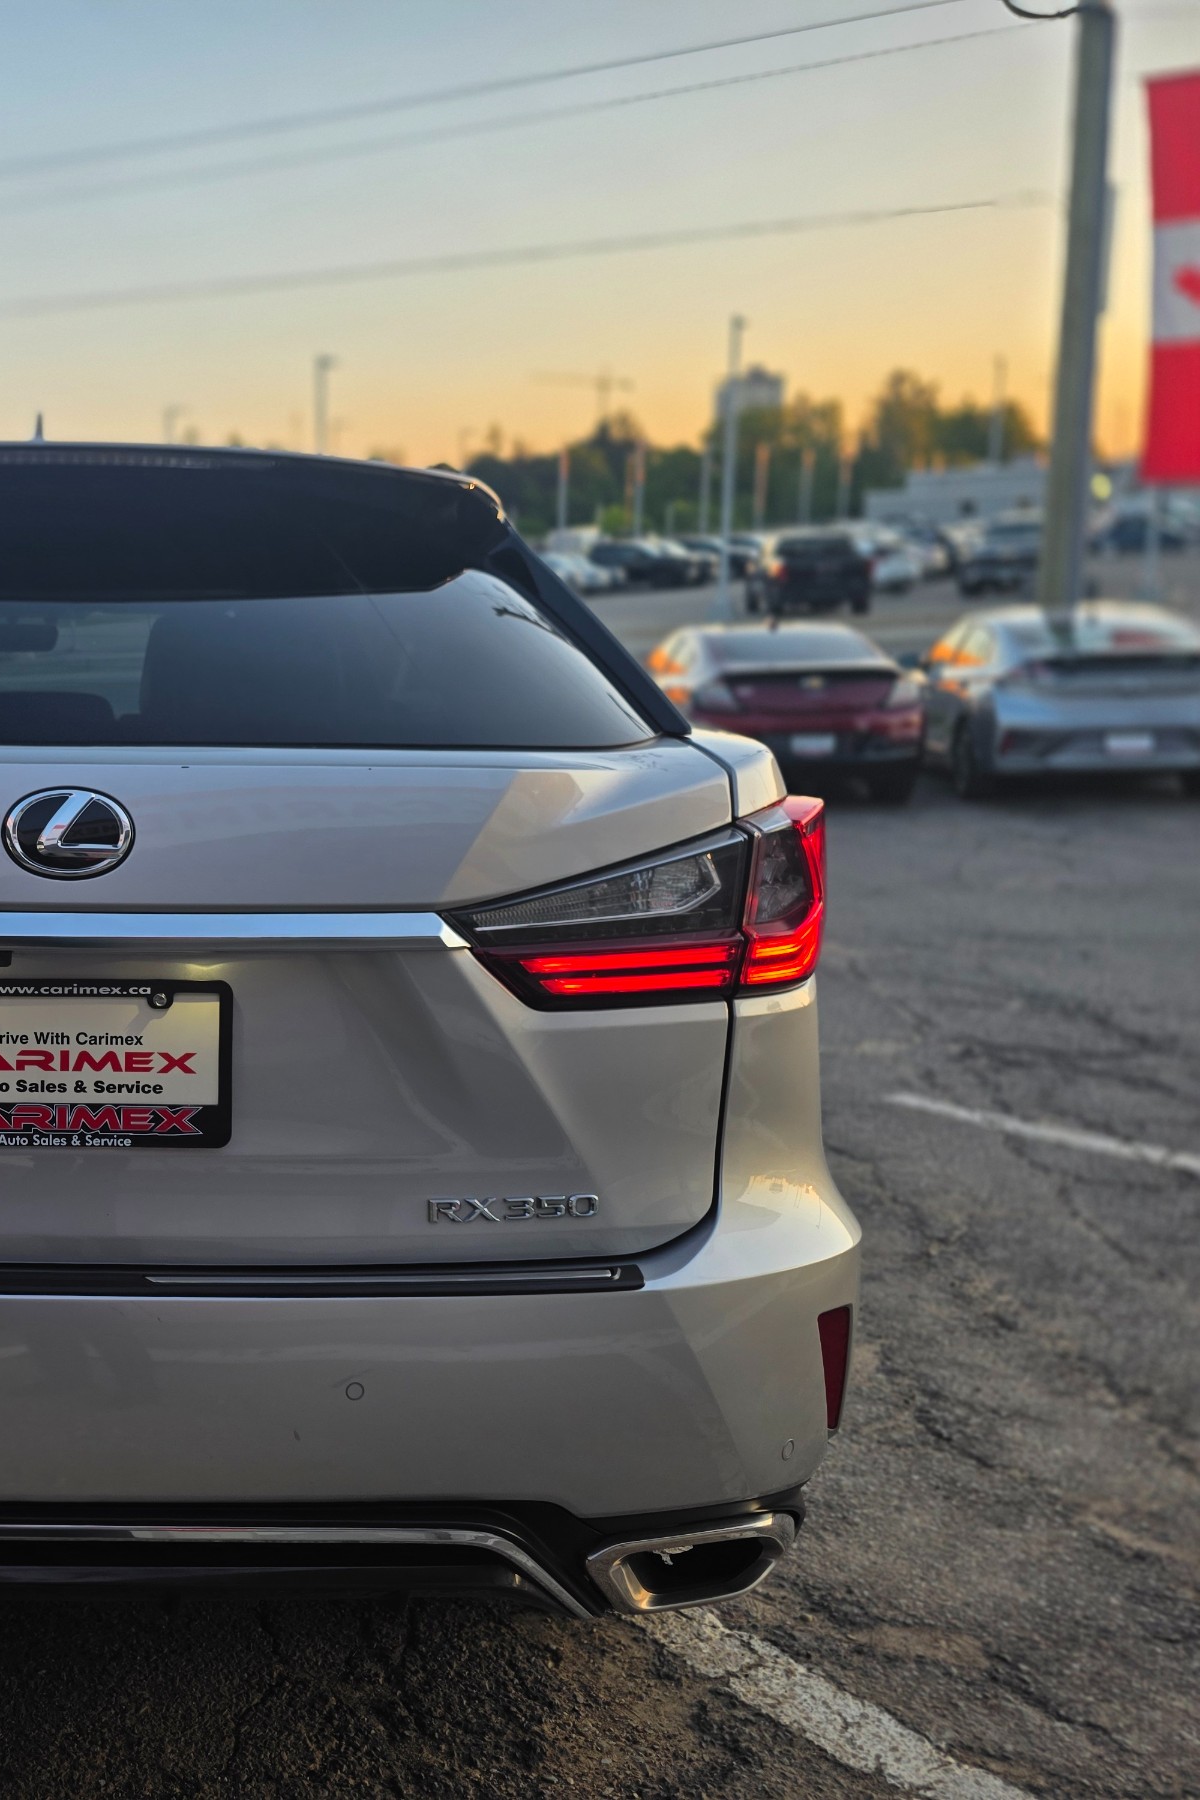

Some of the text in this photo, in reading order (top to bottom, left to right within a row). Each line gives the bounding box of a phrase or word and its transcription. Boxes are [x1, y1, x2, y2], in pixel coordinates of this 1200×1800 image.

[34, 1031, 70, 1045] With
[75, 1031, 144, 1046] Carimex
[16, 1079, 67, 1093] Sales
[73, 1080, 88, 1093] &
[93, 1080, 164, 1094] Service
[32, 1134, 67, 1146] Sales
[71, 1135, 81, 1146] &
[85, 1134, 132, 1147] Service
